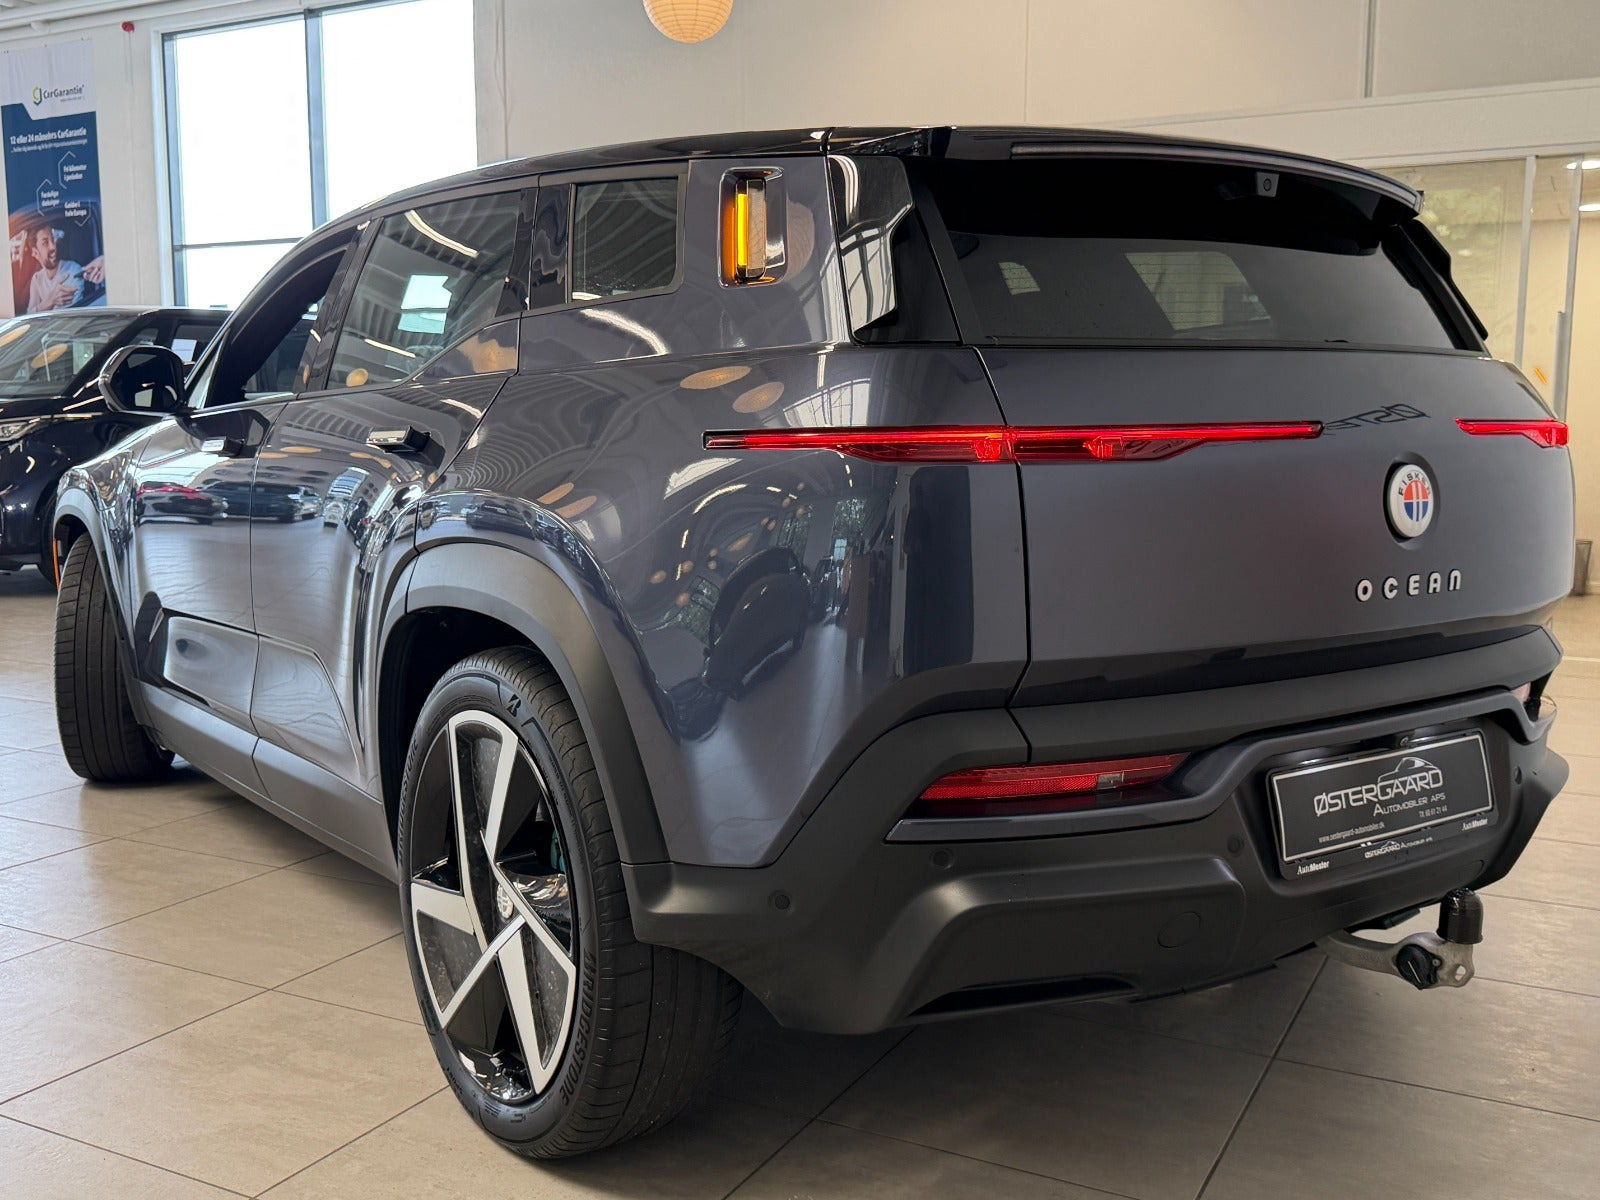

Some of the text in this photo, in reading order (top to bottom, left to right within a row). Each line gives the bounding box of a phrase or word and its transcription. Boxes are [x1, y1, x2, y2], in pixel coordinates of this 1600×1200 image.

[1356, 569, 1461, 601] OCEAN
[1313, 769, 1443, 817] ØSTERGAARD
[558, 949, 597, 1106] BRIDGESTONE
